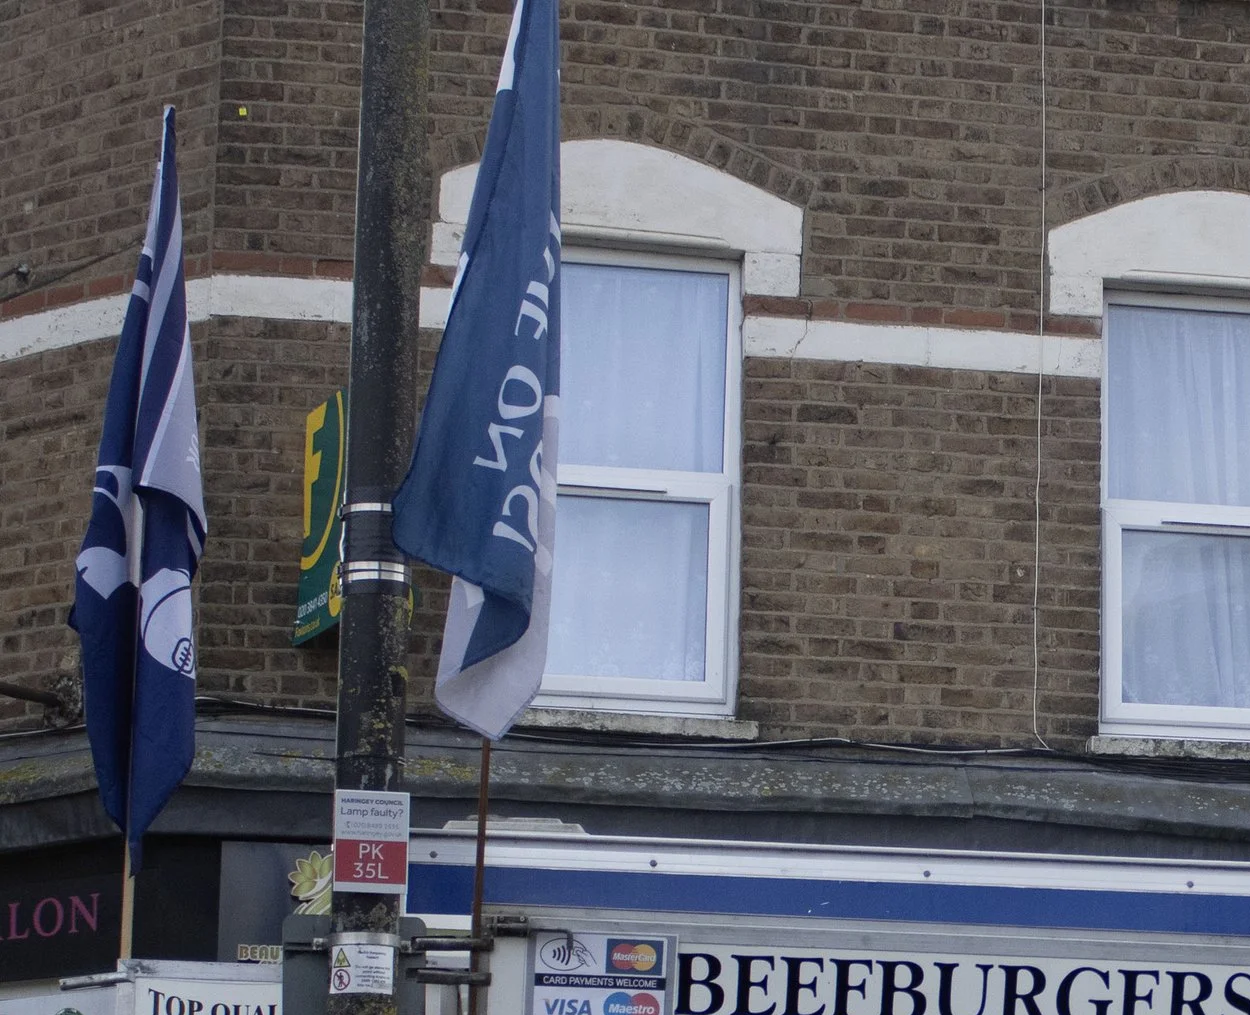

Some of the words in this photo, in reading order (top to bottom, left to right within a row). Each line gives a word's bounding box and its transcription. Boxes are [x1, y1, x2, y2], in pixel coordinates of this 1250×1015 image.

[340, 807, 368, 817] Lamp
[370, 808, 404, 819] faulty?
[359, 843, 384, 860] PK
[352, 862, 389, 879] 35L
[0, 893, 100, 941] LON
[238, 944, 283, 960] BEAU
[612, 952, 657, 962] MasterCard
[543, 976, 567, 985] CARD
[568, 977, 614, 986] PAYMENTS
[615, 979, 657, 988] WELCOME
[608, 1003, 655, 1015] Maestro
